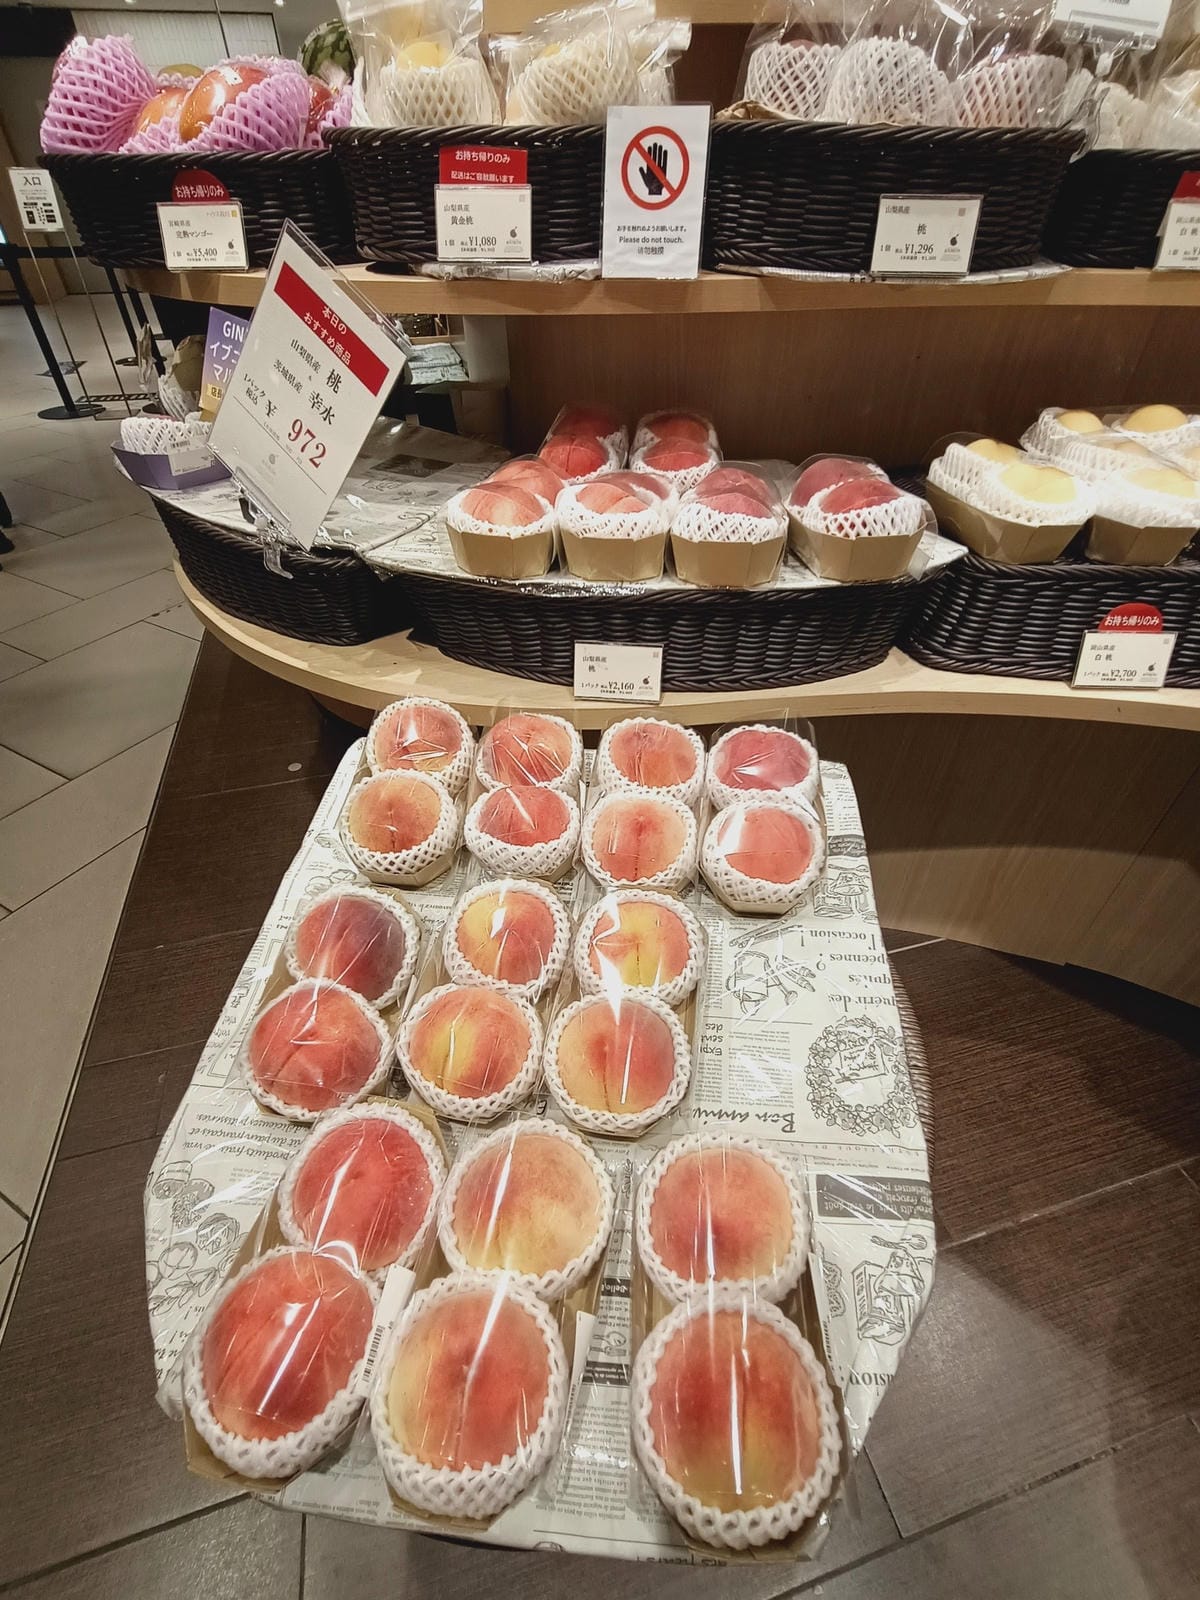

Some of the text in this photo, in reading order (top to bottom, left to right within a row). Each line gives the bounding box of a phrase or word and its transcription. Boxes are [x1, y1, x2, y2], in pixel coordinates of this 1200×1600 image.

[455, 150, 510, 164] お持ち帰りのみ
[24, 176, 42, 186] 入口
[174, 185, 224, 198] お持ち帰りのみ
[450, 216, 474, 225] 黄金桃
[176, 230, 214, 238] 完熟マンゴー
[917, 223, 927, 235] 桃
[468, 236, 497, 248] ¥1,080
[193, 247, 217, 257] ¥5,400
[904, 243, 934, 255] ¥1,296
[322, 306, 348, 335] 本日の
[223, 320, 248, 343] GIN
[302, 311, 352, 366] おすすめ商品
[290, 339, 342, 394] 山梨県産 桃
[273, 359, 335, 426] 茨城県産 幸水
[264, 399, 279, 418] ¥
[288, 418, 327, 468] 972
[1104, 615, 1160, 626] お持ち帰りのみ
[588, 665, 596, 673] 桃
[1111, 669, 1137, 678] ¥2,700
[608, 681, 634, 691] ¥2,160
[810, 930, 876, 951] l'occasion
[705, 1023, 723, 1032] des
[249, 1119, 302, 1133] délicieuses
[755, 1112, 796, 1134] Bon
[188, 1127, 200, 1135] et
[201, 1128, 245, 1140] français
[271, 1136, 287, 1146] du
[245, 1147, 289, 1161] produits
